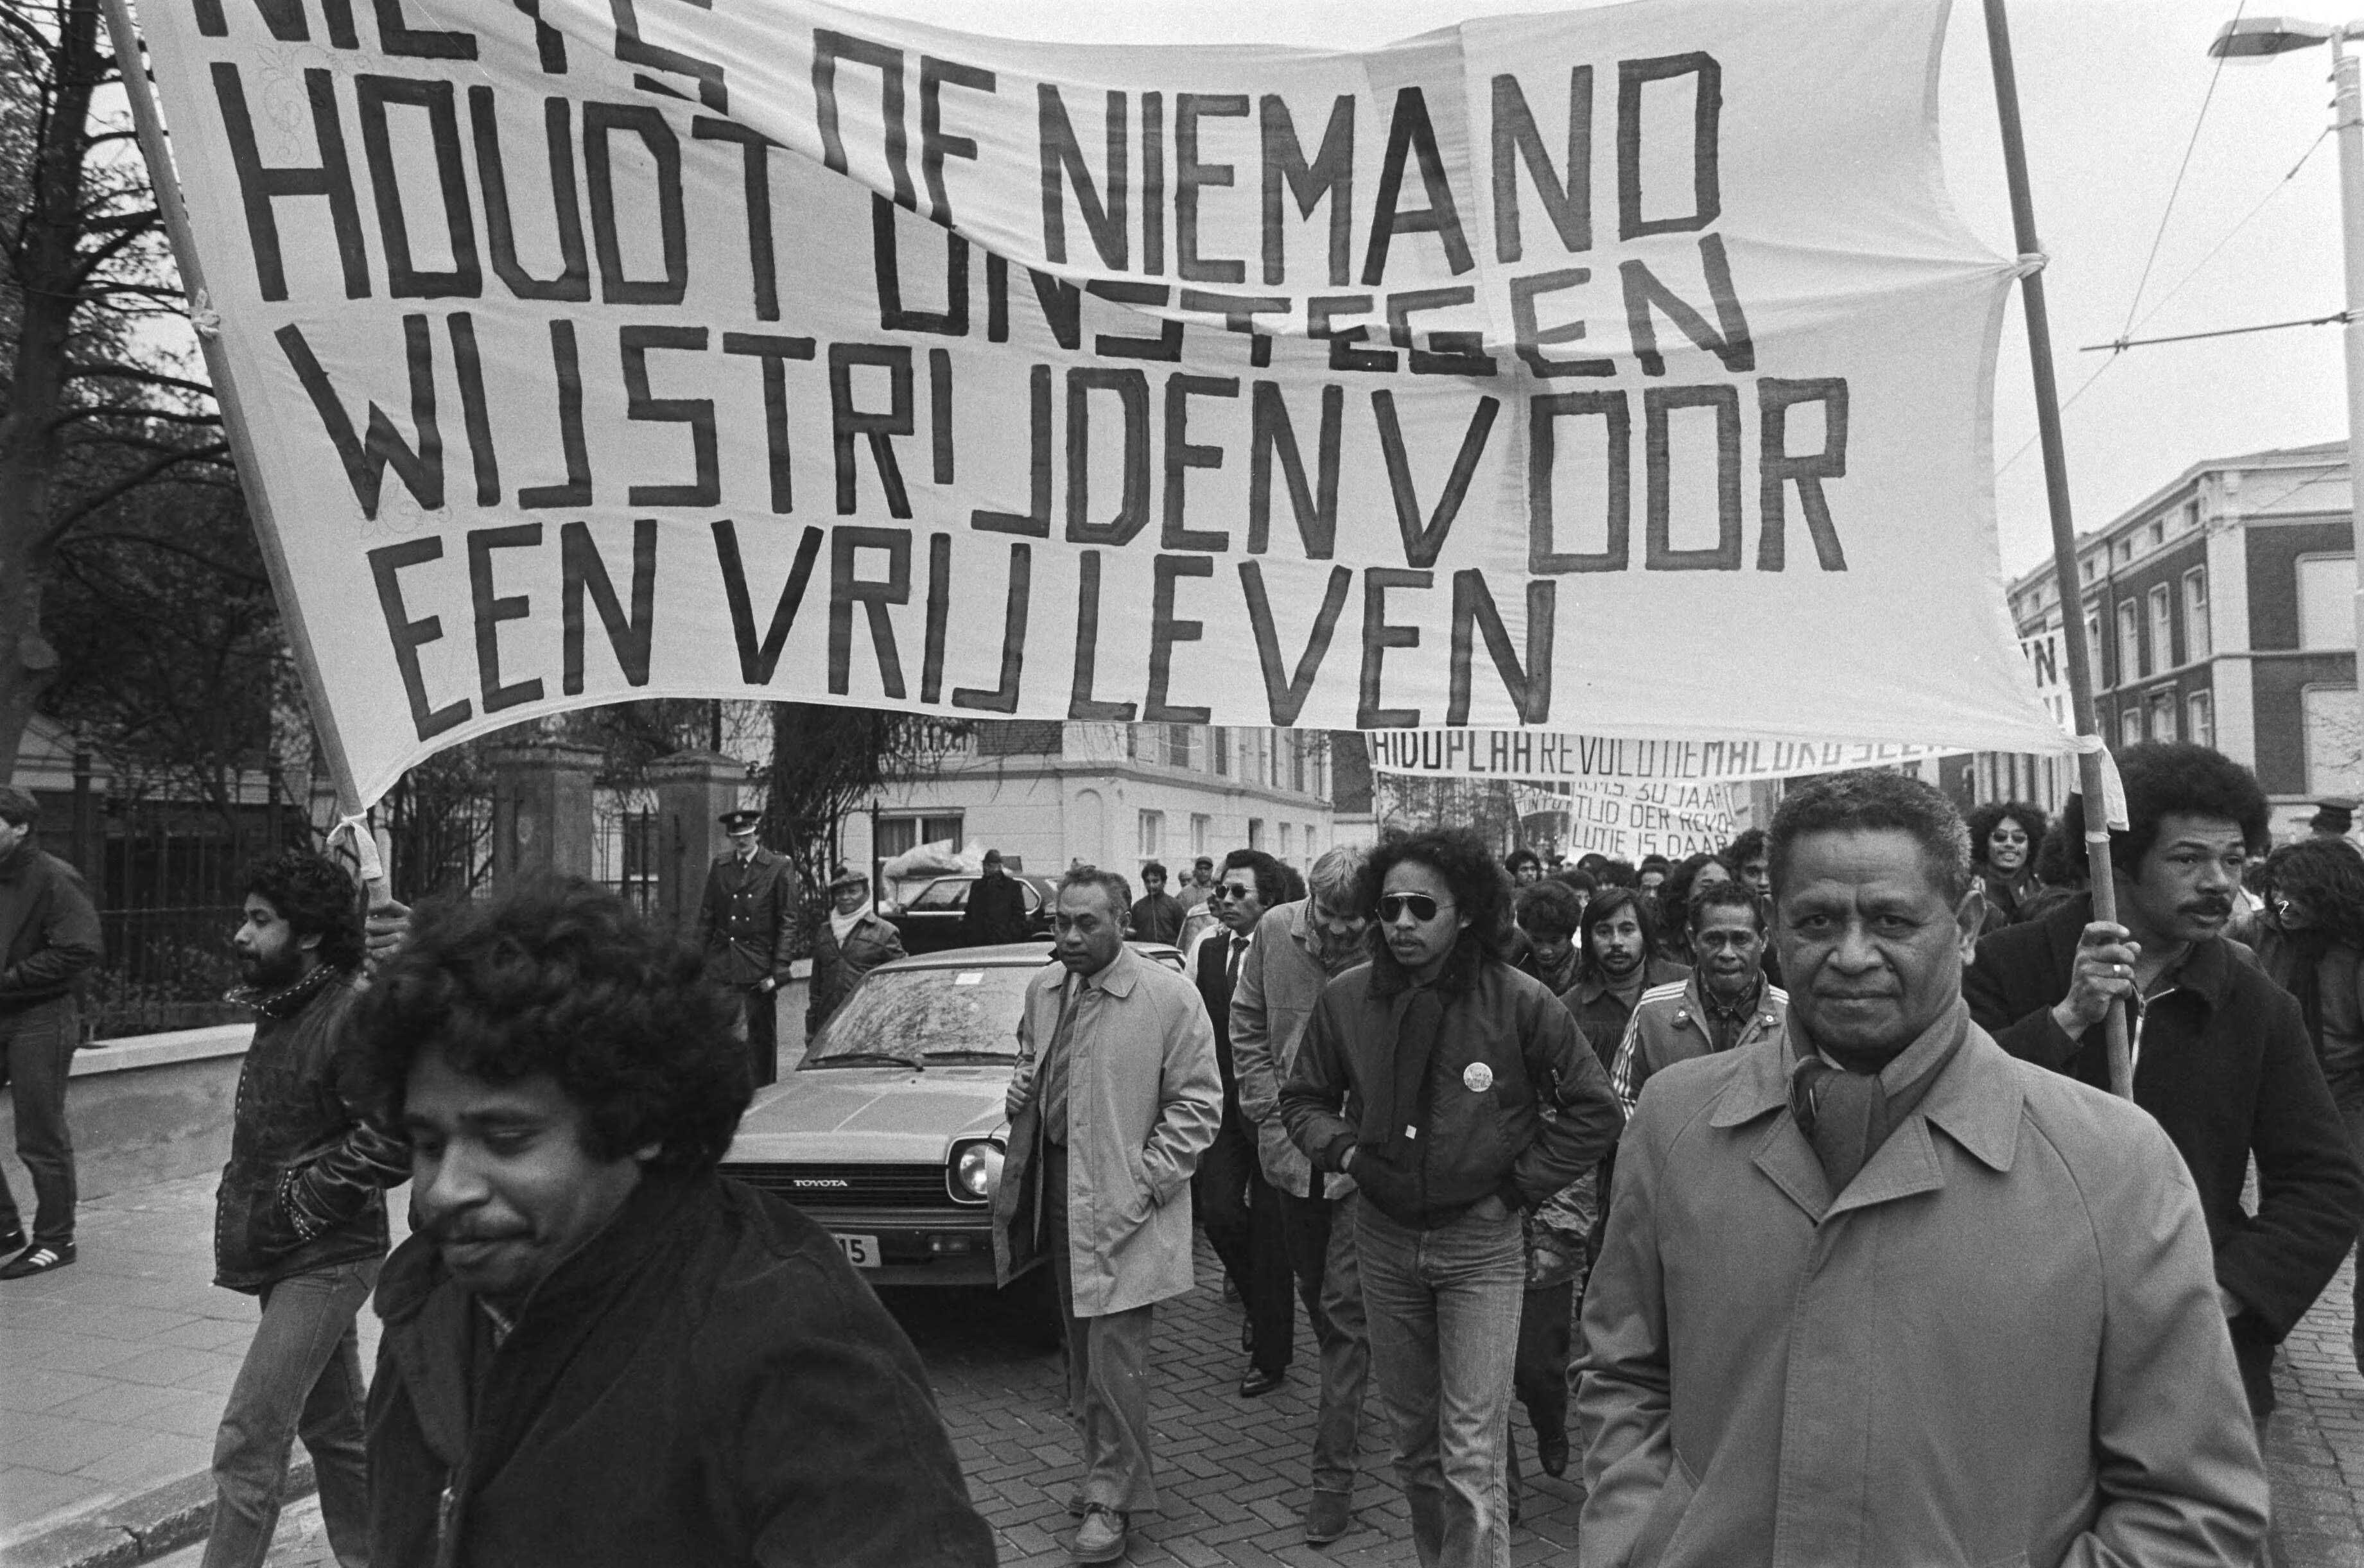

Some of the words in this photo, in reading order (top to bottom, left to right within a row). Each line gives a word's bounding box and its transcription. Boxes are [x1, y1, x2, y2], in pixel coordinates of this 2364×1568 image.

[210, 62, 794, 321] HOUDT
[1038, 51, 1721, 286] NIEMAND
[274, 311, 593, 521] WIJ
[620, 325, 1343, 559] STRIJDEN
[1371, 377, 1849, 575] VOOR
[367, 519, 657, 742] EEN
[711, 519, 1031, 714] VRIJ
[1068, 550, 1556, 730] LEVEN
[1572, 823, 1627, 855] LUTIE
[1638, 832, 1656, 855] IS
[1667, 834, 1727, 857] DAAR
[1576, 794, 1619, 824] TIJD
[1630, 803, 1670, 831] DER
